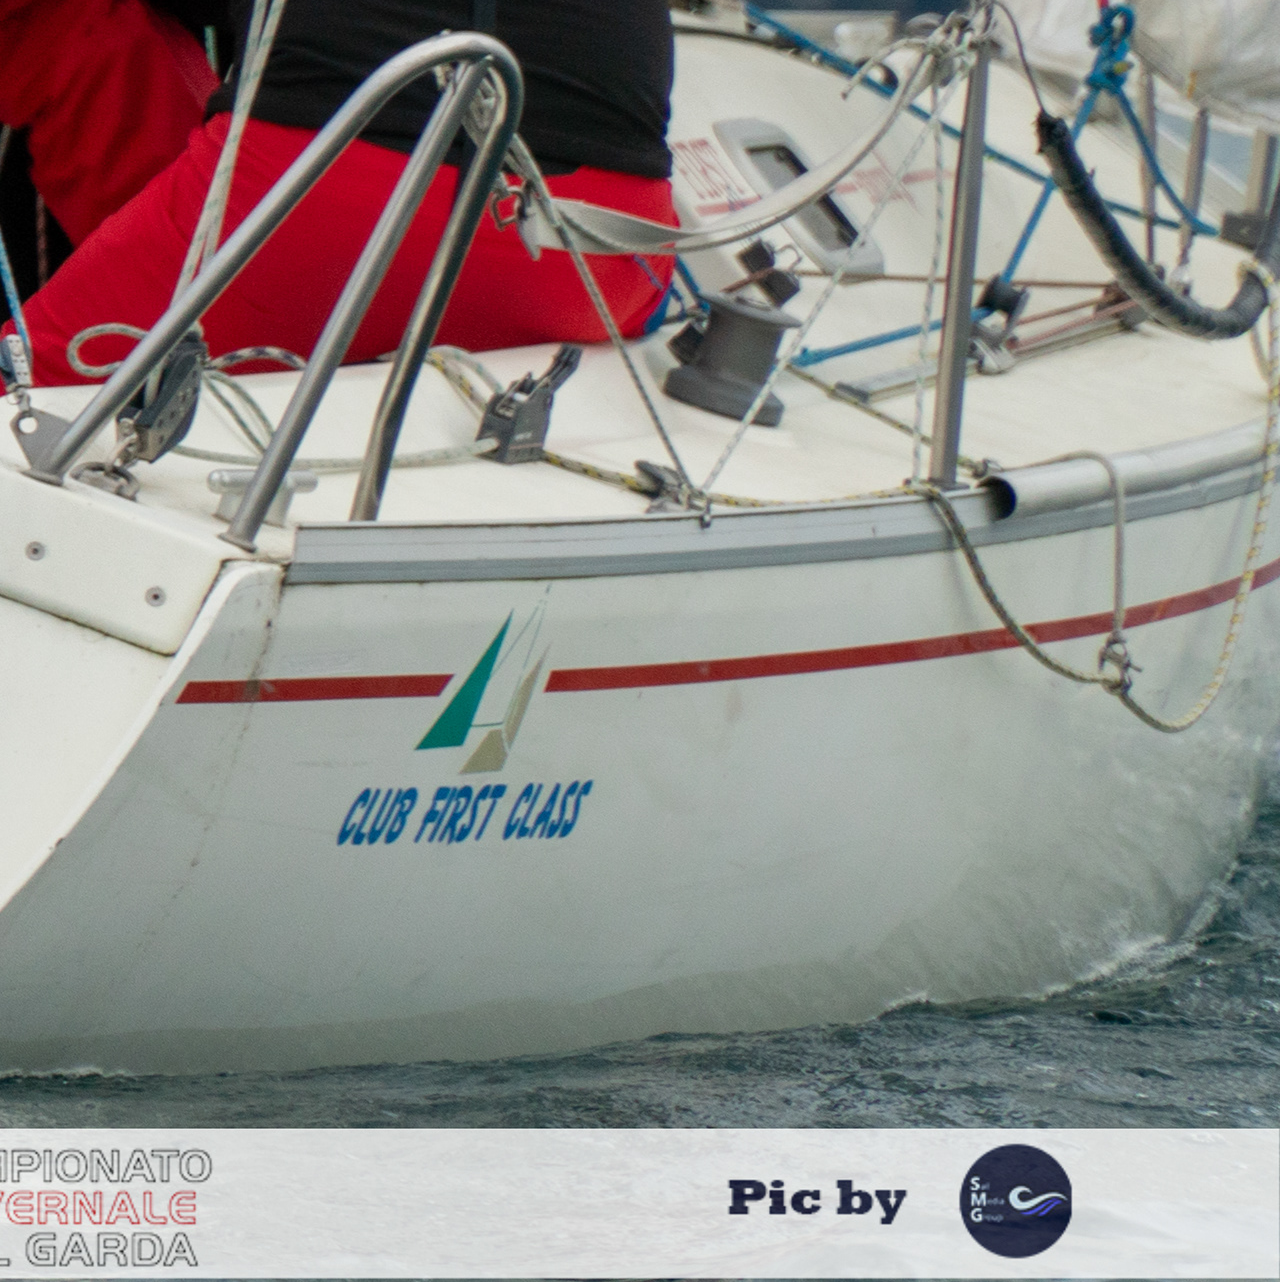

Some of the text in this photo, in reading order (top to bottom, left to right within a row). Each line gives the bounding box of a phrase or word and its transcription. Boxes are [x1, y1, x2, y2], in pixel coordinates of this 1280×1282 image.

[337, 779, 594, 846] CLUB FIRST CLASS
